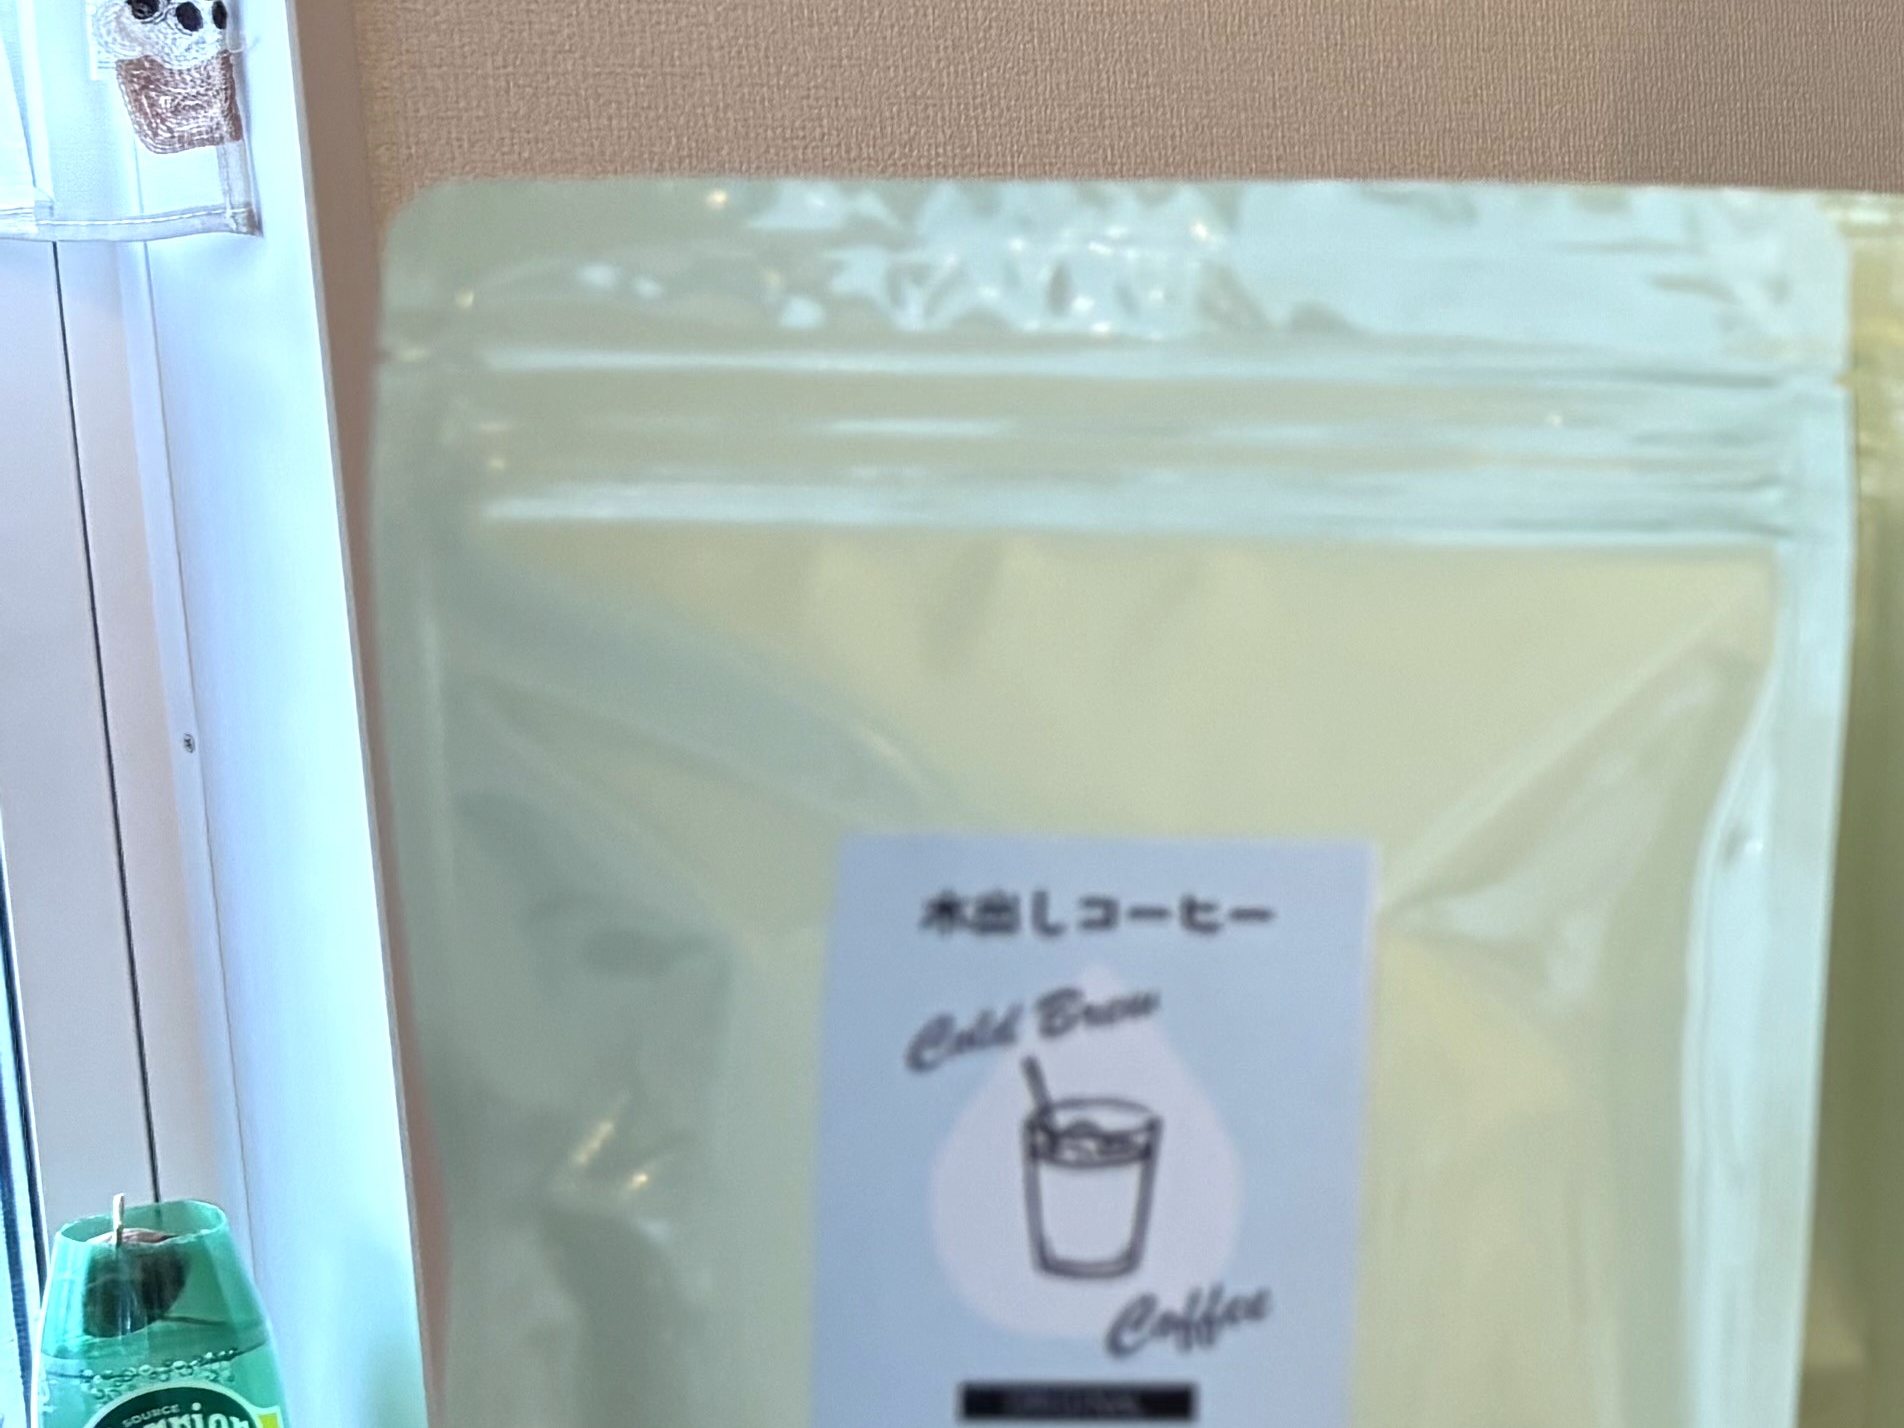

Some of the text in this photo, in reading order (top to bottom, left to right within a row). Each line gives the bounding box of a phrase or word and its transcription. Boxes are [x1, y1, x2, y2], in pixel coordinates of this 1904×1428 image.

[918, 888, 1277, 938] 水出しコーヒー
[905, 1003, 1023, 1075] Cold
[1103, 1286, 1274, 1360] Coffee
